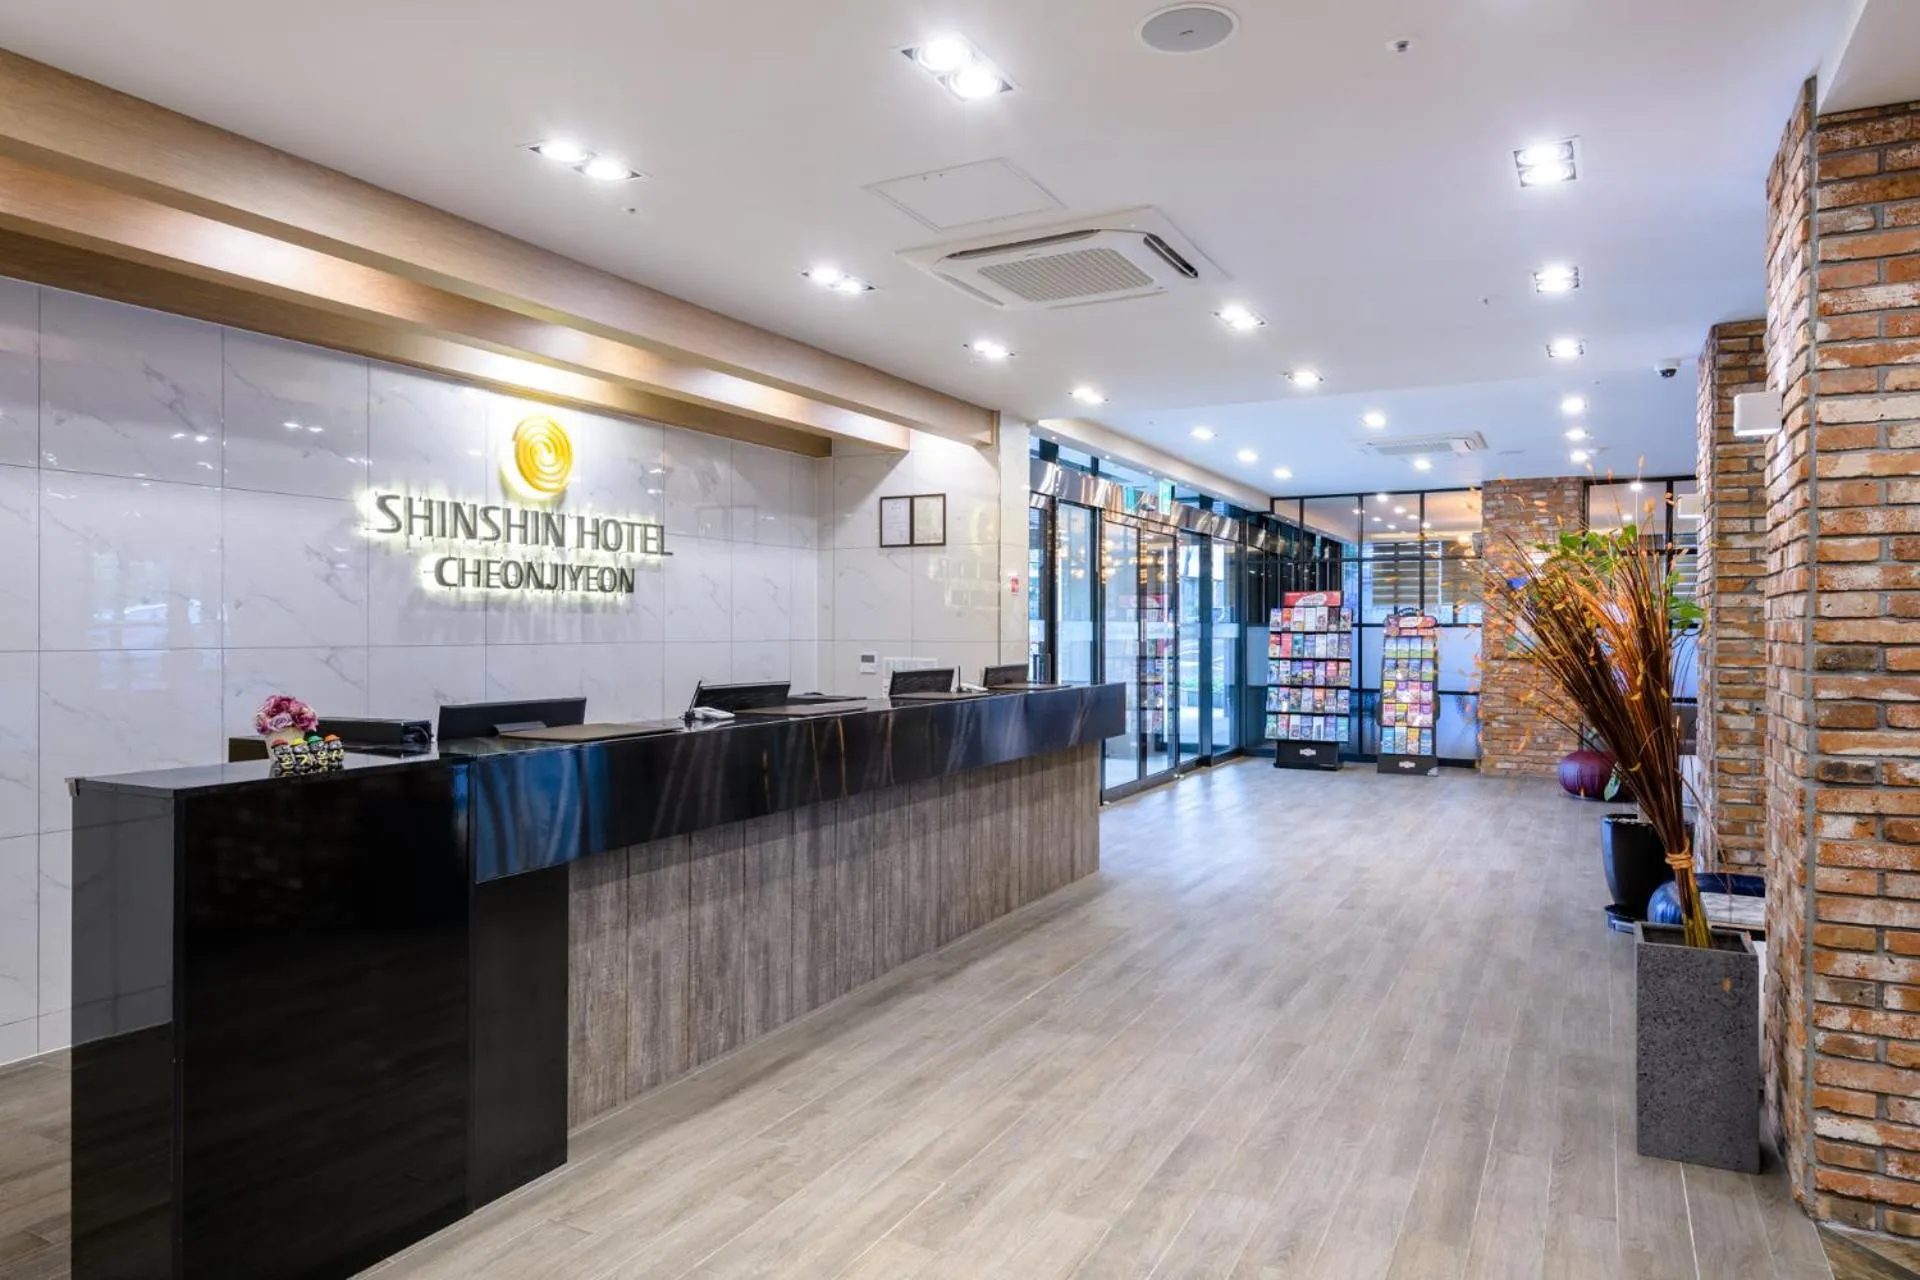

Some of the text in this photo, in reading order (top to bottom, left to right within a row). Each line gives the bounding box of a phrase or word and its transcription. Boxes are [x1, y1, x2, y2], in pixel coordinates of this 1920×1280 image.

[376, 495, 673, 556] SHINSHIN HOTEL
[434, 556, 635, 594] CHEONJIYEON
